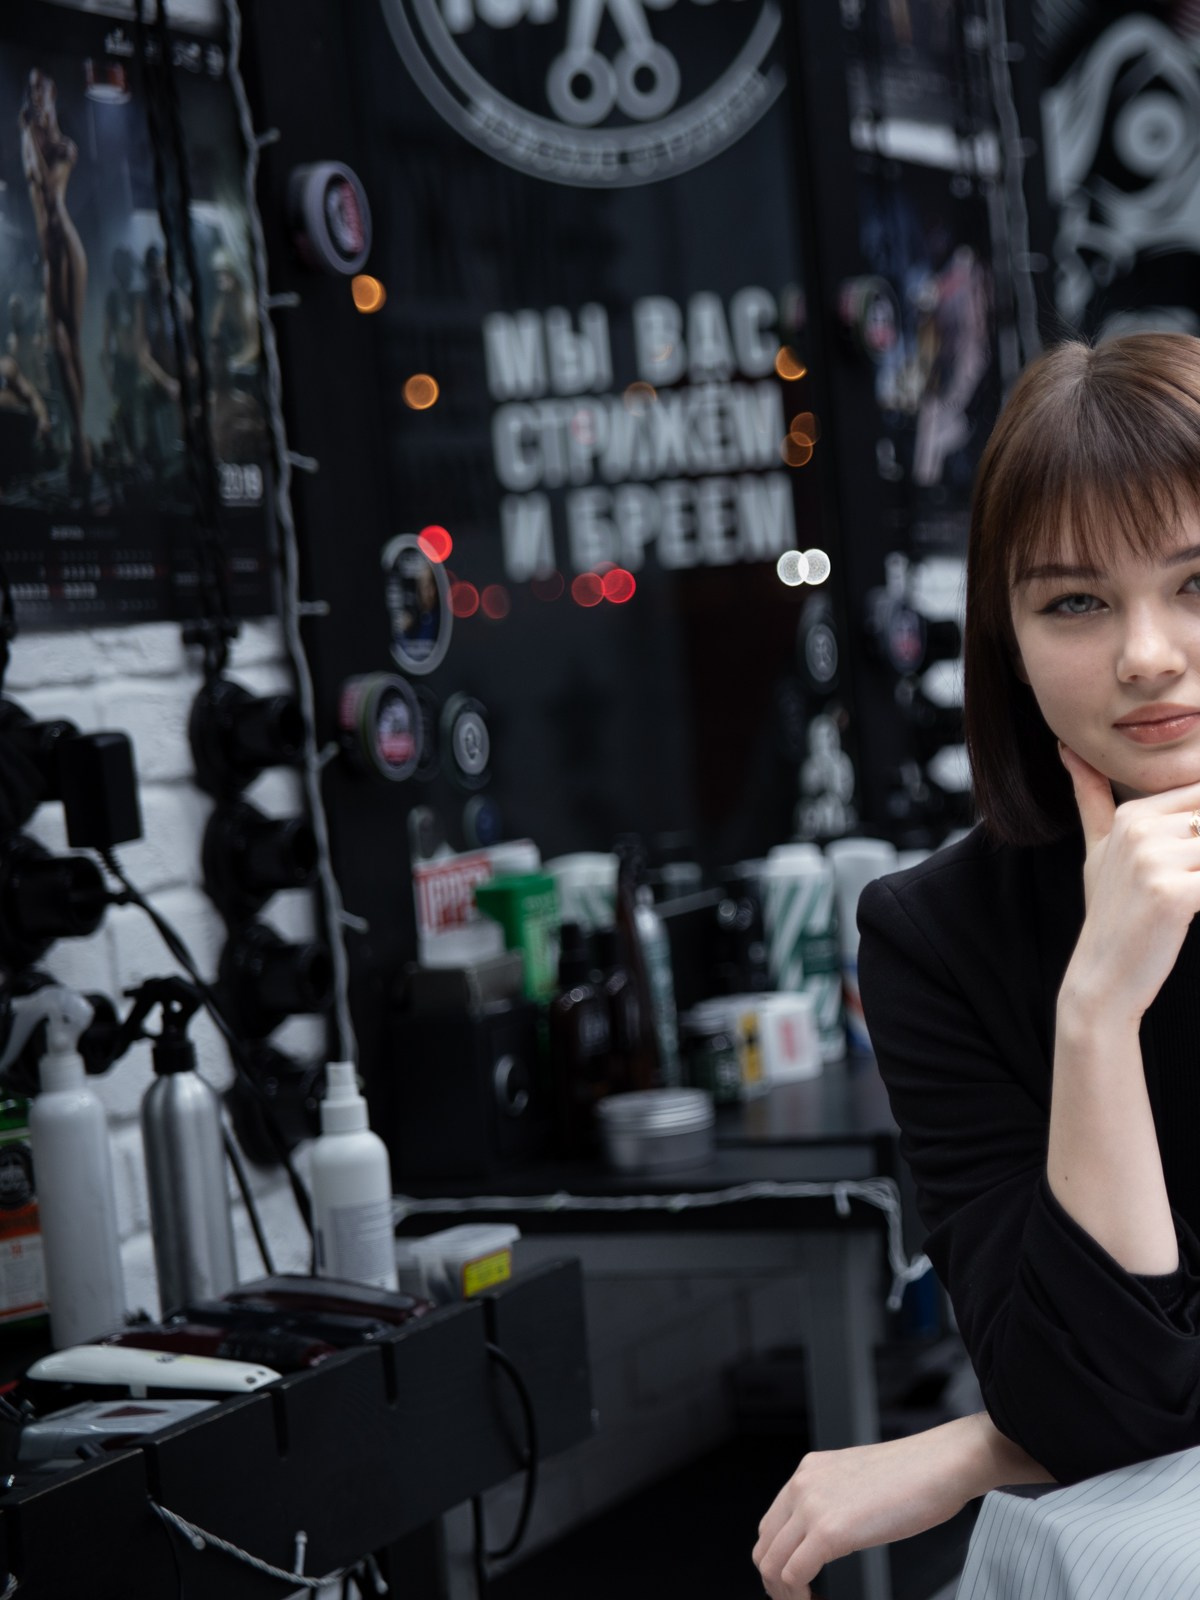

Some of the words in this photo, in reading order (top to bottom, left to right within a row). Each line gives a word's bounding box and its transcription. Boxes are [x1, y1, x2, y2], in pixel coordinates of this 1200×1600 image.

[483, 303, 613, 399] МЫ
[633, 287, 781, 386] ВАС
[502, 492, 556, 582] И
[566, 470, 798, 574] БРЕЕМ
